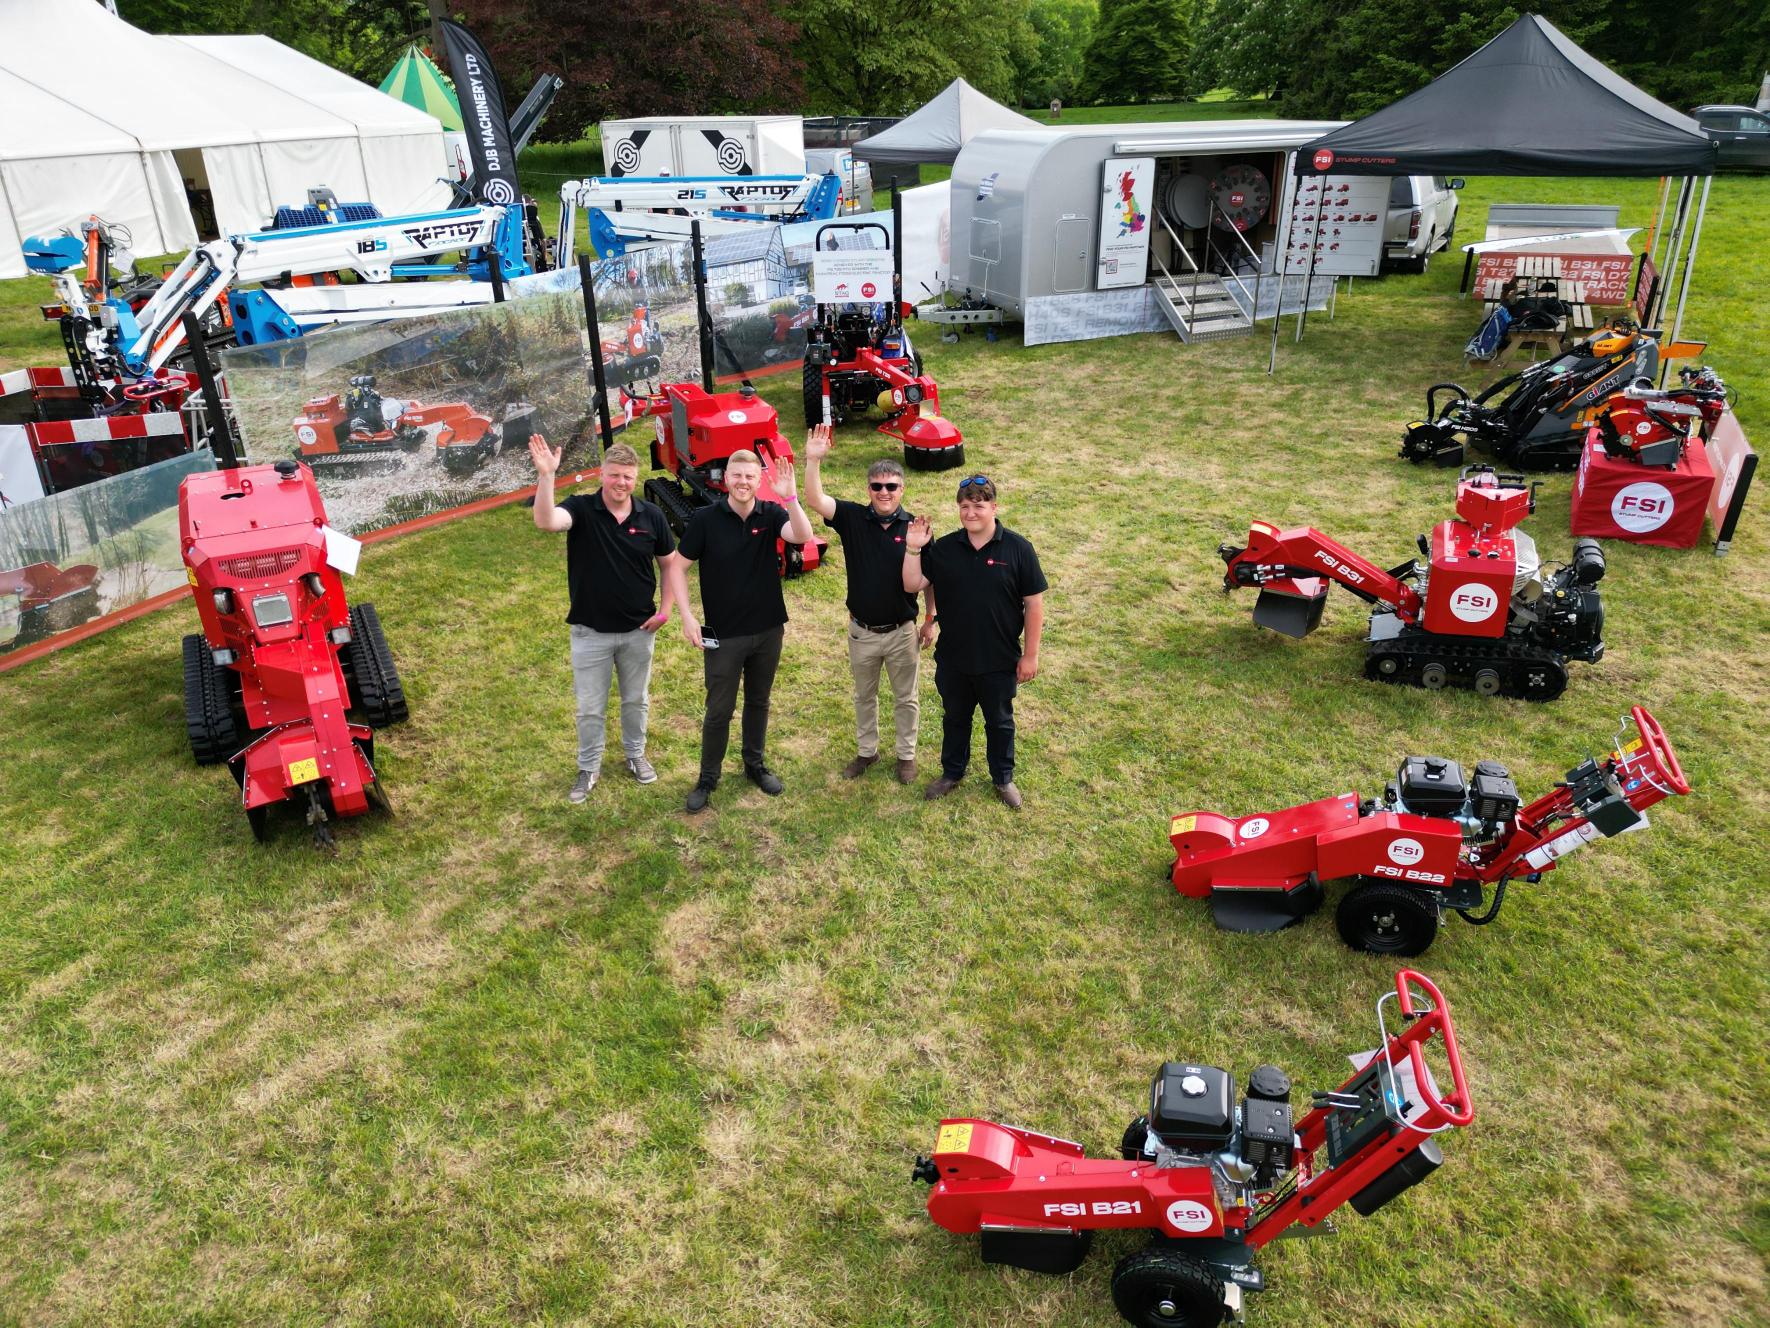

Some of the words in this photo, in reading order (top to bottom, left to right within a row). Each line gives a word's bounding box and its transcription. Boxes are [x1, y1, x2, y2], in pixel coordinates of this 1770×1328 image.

[465, 53, 481, 75] LTD
[470, 77, 497, 147] MACHINERY
[486, 149, 501, 171] DJB
[719, 184, 799, 201] RAPTOR
[1478, 257, 1500, 266] FSI
[1570, 260, 1598, 269] B31
[1601, 261, 1626, 270] FSI
[1581, 270, 1606, 280] FSI
[1591, 290, 1627, 299] 4WD
[1620, 495, 1666, 514] FSI
[1314, 550, 1340, 568] FSI
[1336, 564, 1366, 584] B31
[1456, 594, 1492, 608] FSI
[1250, 821, 1260, 836] FSI
[1393, 845, 1420, 856] FSI
[1373, 865, 1404, 877] FSI
[1405, 869, 1446, 884] B22
[1043, 1202, 1087, 1217] FSI
[1091, 1200, 1142, 1215] B21
[1173, 1210, 1206, 1220] FSI
